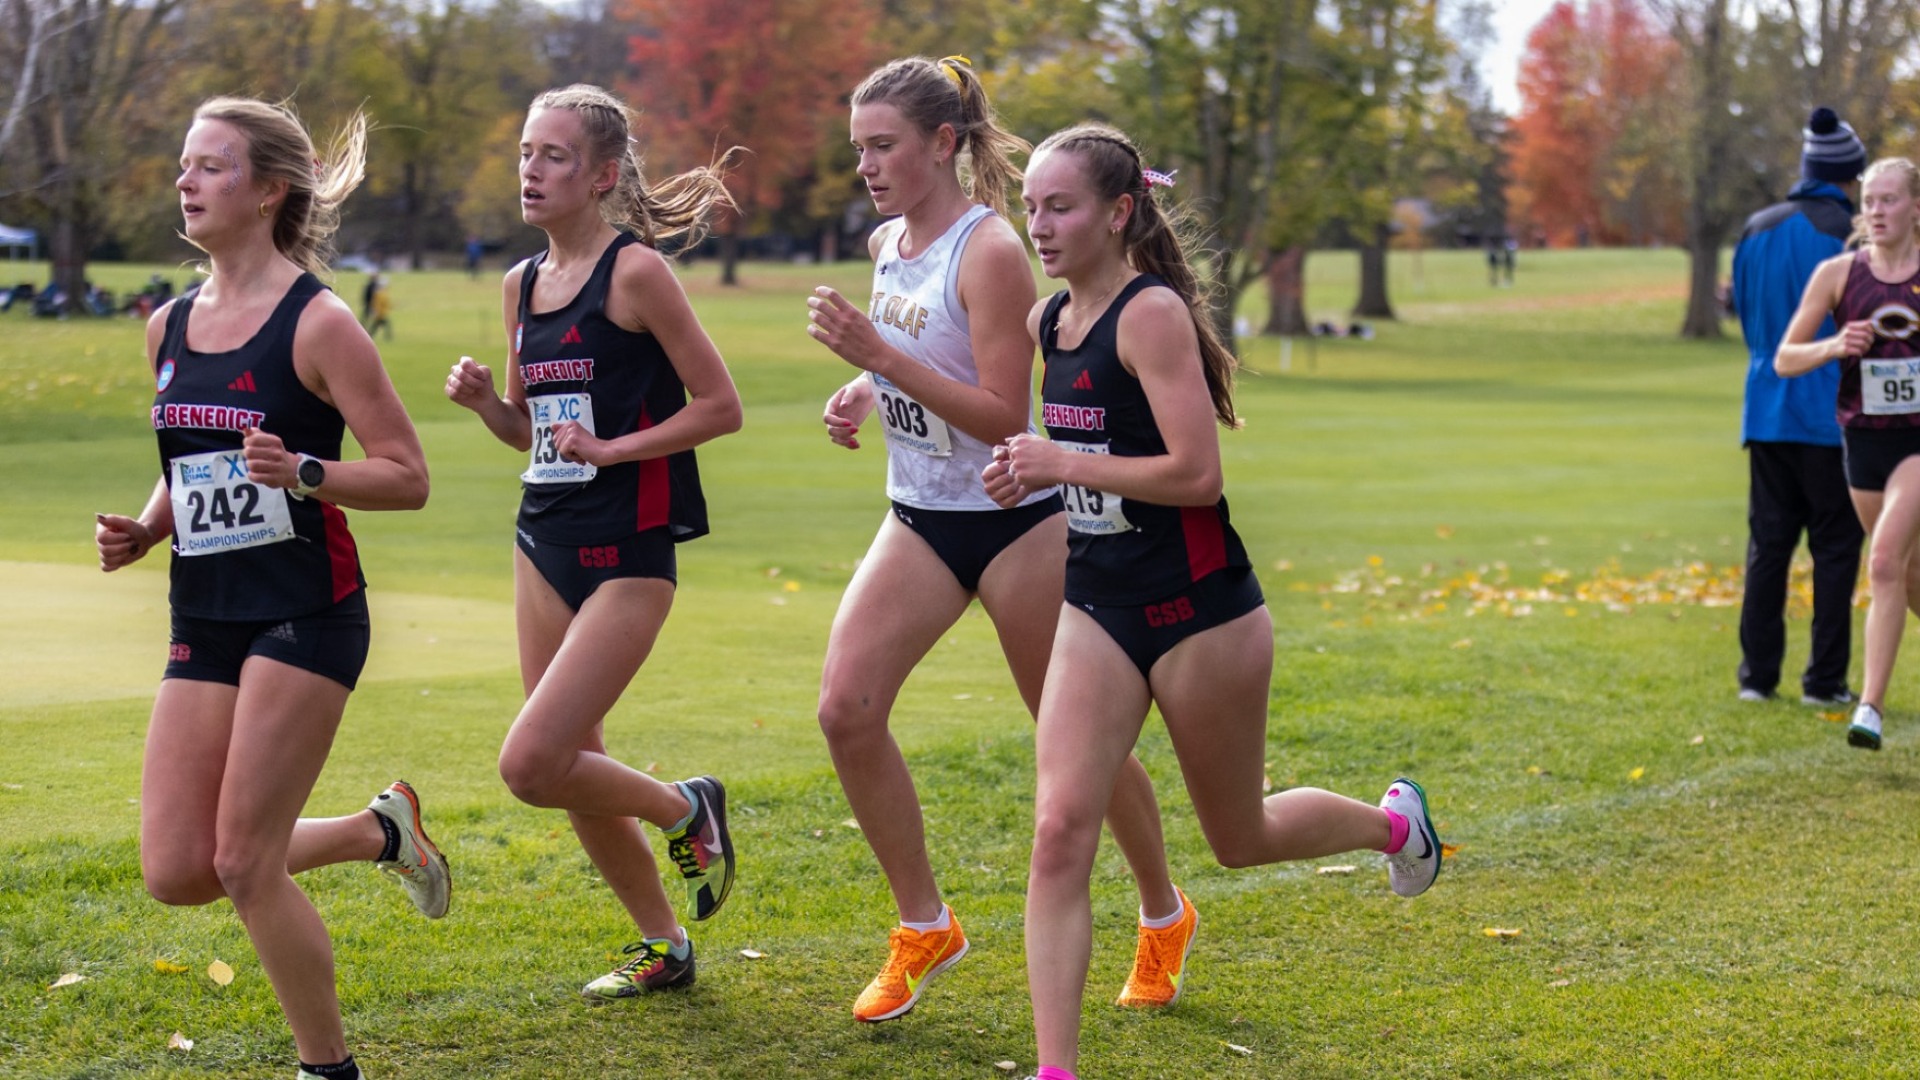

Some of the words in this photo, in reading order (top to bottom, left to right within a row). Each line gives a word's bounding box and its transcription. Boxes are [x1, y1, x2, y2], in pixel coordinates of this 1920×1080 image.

[870, 291, 885, 323] T.
[883, 295, 929, 340] OLAF
[527, 358, 594, 385] BENEDICT
[1883, 379, 1916, 403] 95
[164, 403, 266, 433] BENEDICT
[557, 397, 581, 421] XC
[881, 392, 928, 438] 303
[1044, 403, 1106, 431] BENEDICT
[222, 453, 250, 481] X
[187, 483, 266, 534] 242
[188, 527, 277, 551] CHAMPIONSHIPS
[578, 545, 620, 568] CSB
[1144, 596, 1196, 628] CSB
